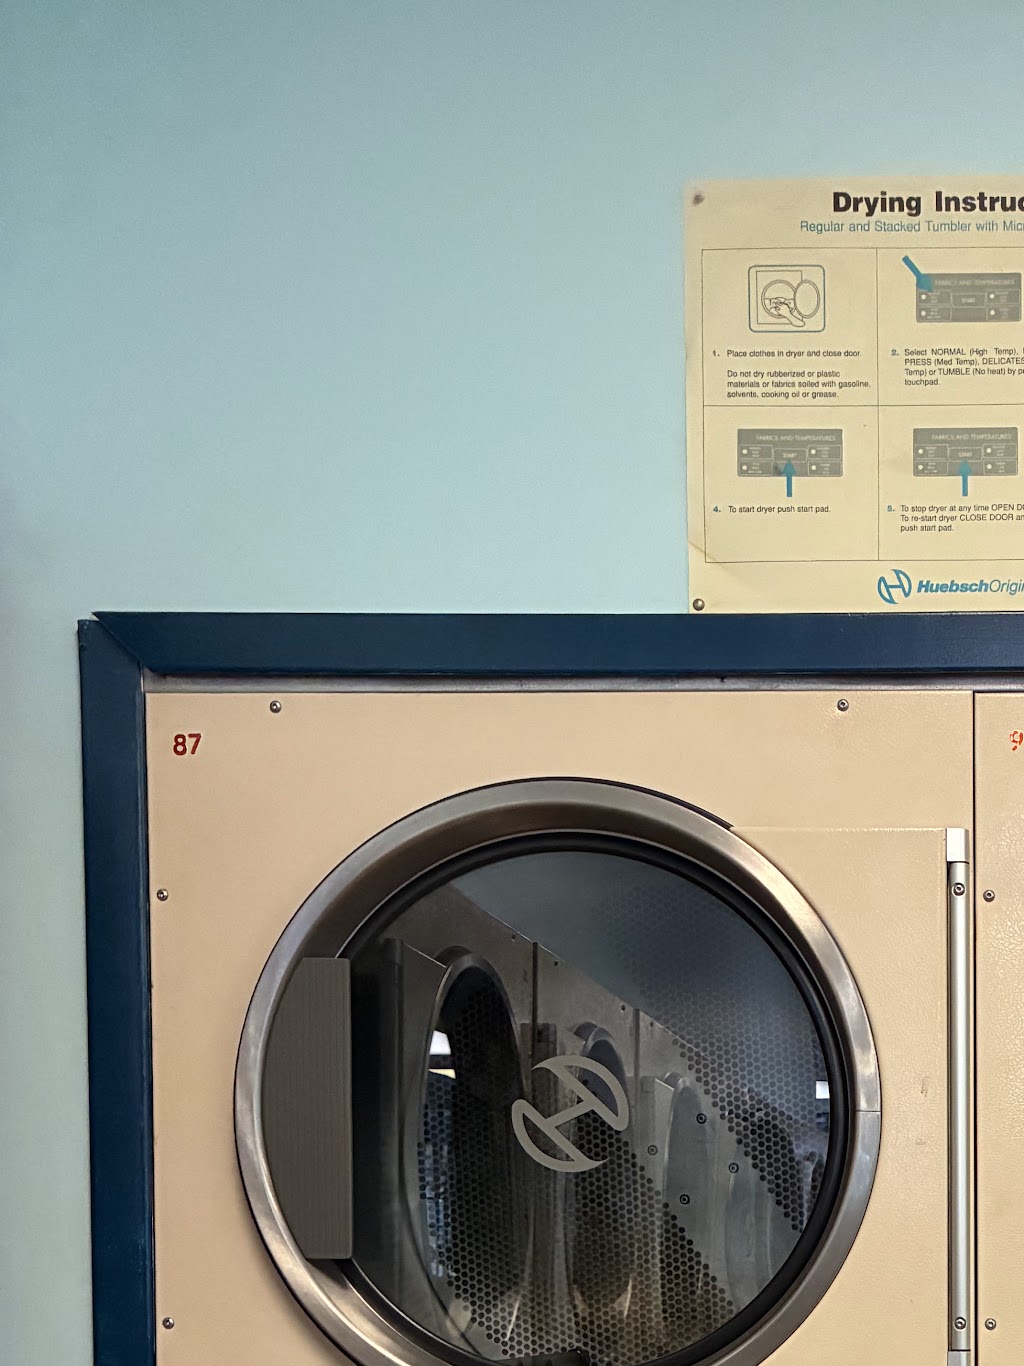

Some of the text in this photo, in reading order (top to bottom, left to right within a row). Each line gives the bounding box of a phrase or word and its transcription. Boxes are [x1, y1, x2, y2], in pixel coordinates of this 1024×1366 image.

[833, 191, 922, 217] Drying
[800, 220, 844, 234] Regular
[849, 220, 871, 231] and
[874, 219, 921, 231] Stacked
[926, 219, 970, 231] Tumbler
[975, 219, 999, 231] with
[786, 350, 804, 359] dryer
[904, 348, 927, 356] Select
[931, 348, 966, 356] NORMAL
[969, 348, 988, 357] (High
[904, 358, 932, 366] PRESS
[934, 358, 953, 367] (Med
[753, 370, 765, 379] dry
[816, 370, 840, 379] plastic
[904, 368, 927, 378] Temp)
[972, 368, 986, 377] (No
[987, 367, 1006, 377] heat)
[1007, 367, 1016, 377] by
[904, 378, 940, 387] touchpad.
[761, 390, 789, 399] cooking
[791, 390, 800, 398] oil
[738, 505, 755, 513] start
[756, 505, 775, 515] dryer
[777, 505, 795, 515] push
[797, 505, 813, 513] start
[815, 505, 831, 515] pad.
[911, 504, 927, 514] stop
[928, 504, 947, 514] dryer
[900, 514, 909, 522] To
[911, 514, 937, 522] re-start
[938, 514, 957, 523] dryer
[989, 513, 1014, 521] DOOR
[900, 524, 918, 533] push
[938, 524, 954, 533] pad.
[173, 733, 201, 756] 87
